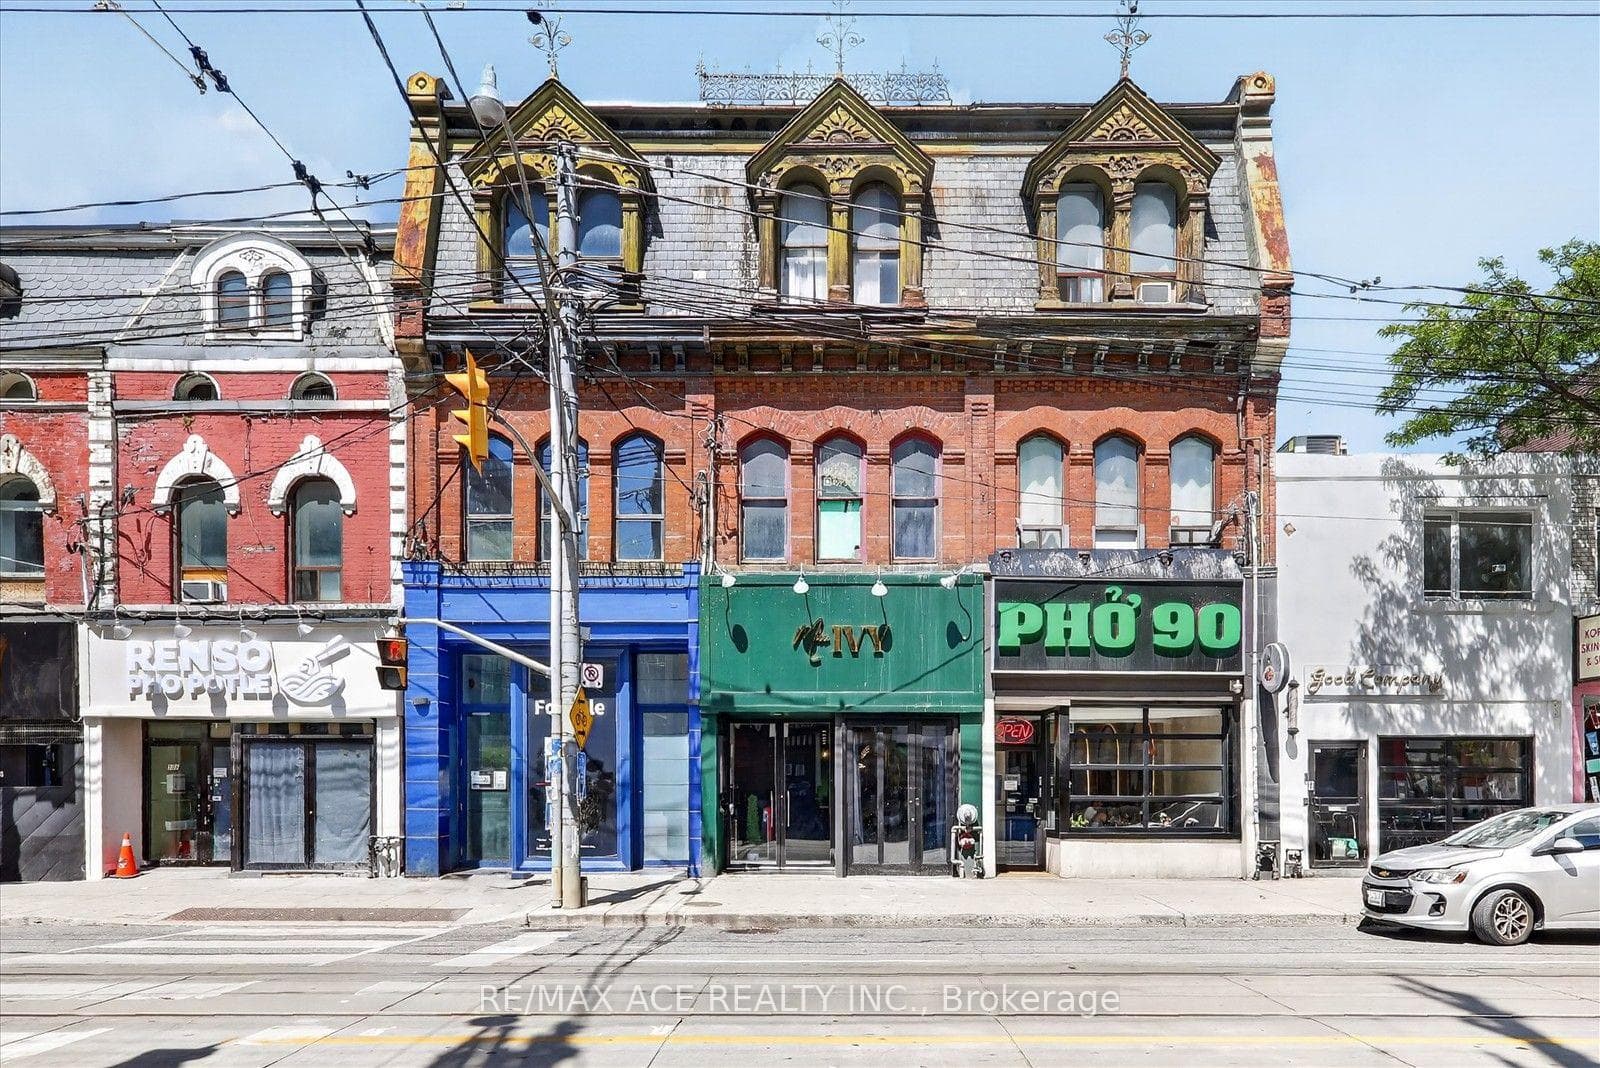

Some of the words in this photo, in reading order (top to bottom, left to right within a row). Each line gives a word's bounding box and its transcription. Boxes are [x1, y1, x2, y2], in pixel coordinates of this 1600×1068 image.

[832, 624, 891, 655] IVY
[1153, 602, 1241, 652] 90
[127, 639, 272, 673] RENSO
[1307, 666, 1356, 695] Good
[1361, 667, 1443, 694] Company
[995, 723, 1031, 738] OPEN
